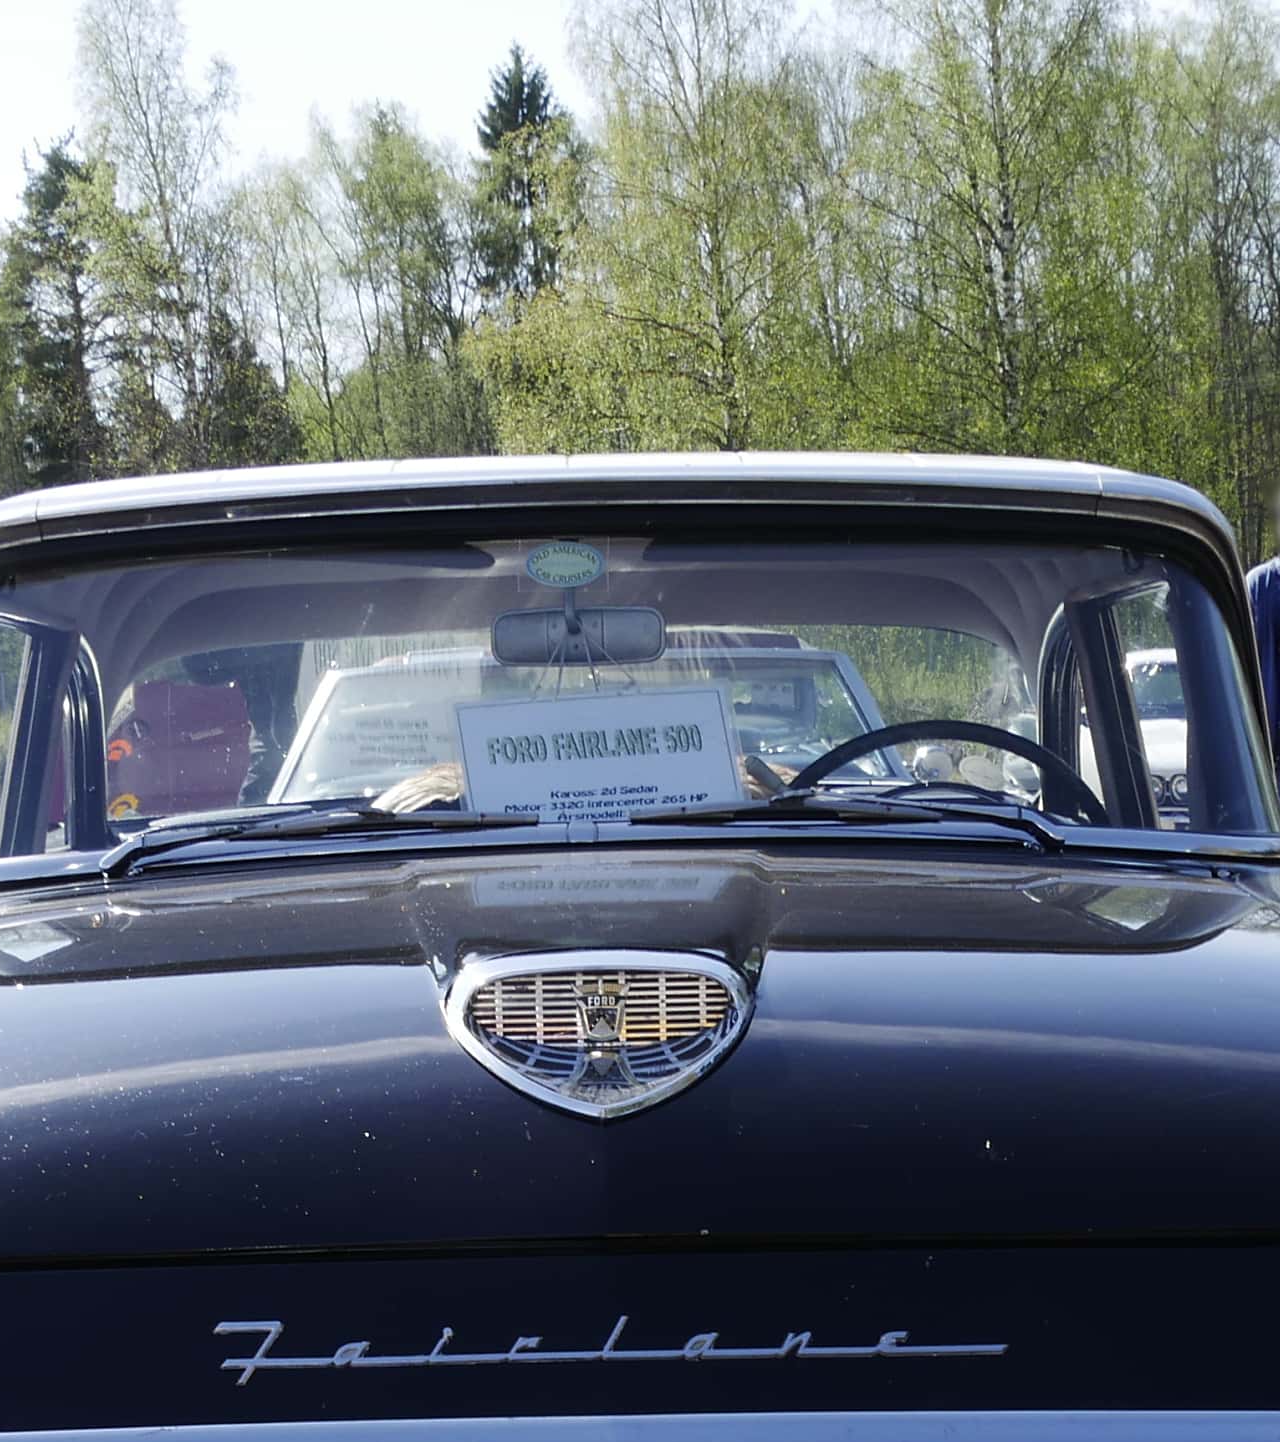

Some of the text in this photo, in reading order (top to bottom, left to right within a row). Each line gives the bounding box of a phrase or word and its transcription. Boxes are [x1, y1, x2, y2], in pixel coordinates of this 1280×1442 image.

[487, 734, 547, 765] FORD
[552, 726, 661, 761] FAIRLANE
[664, 723, 704, 753] 500
[601, 785, 619, 797] 2d
[621, 783, 659, 795] Sedan
[504, 802, 547, 814] Motor:
[661, 794, 687, 805] 265
[689, 792, 709, 804] HP
[587, 995, 616, 1007] FORD
[213, 1315, 1009, 1387] Fairlane
